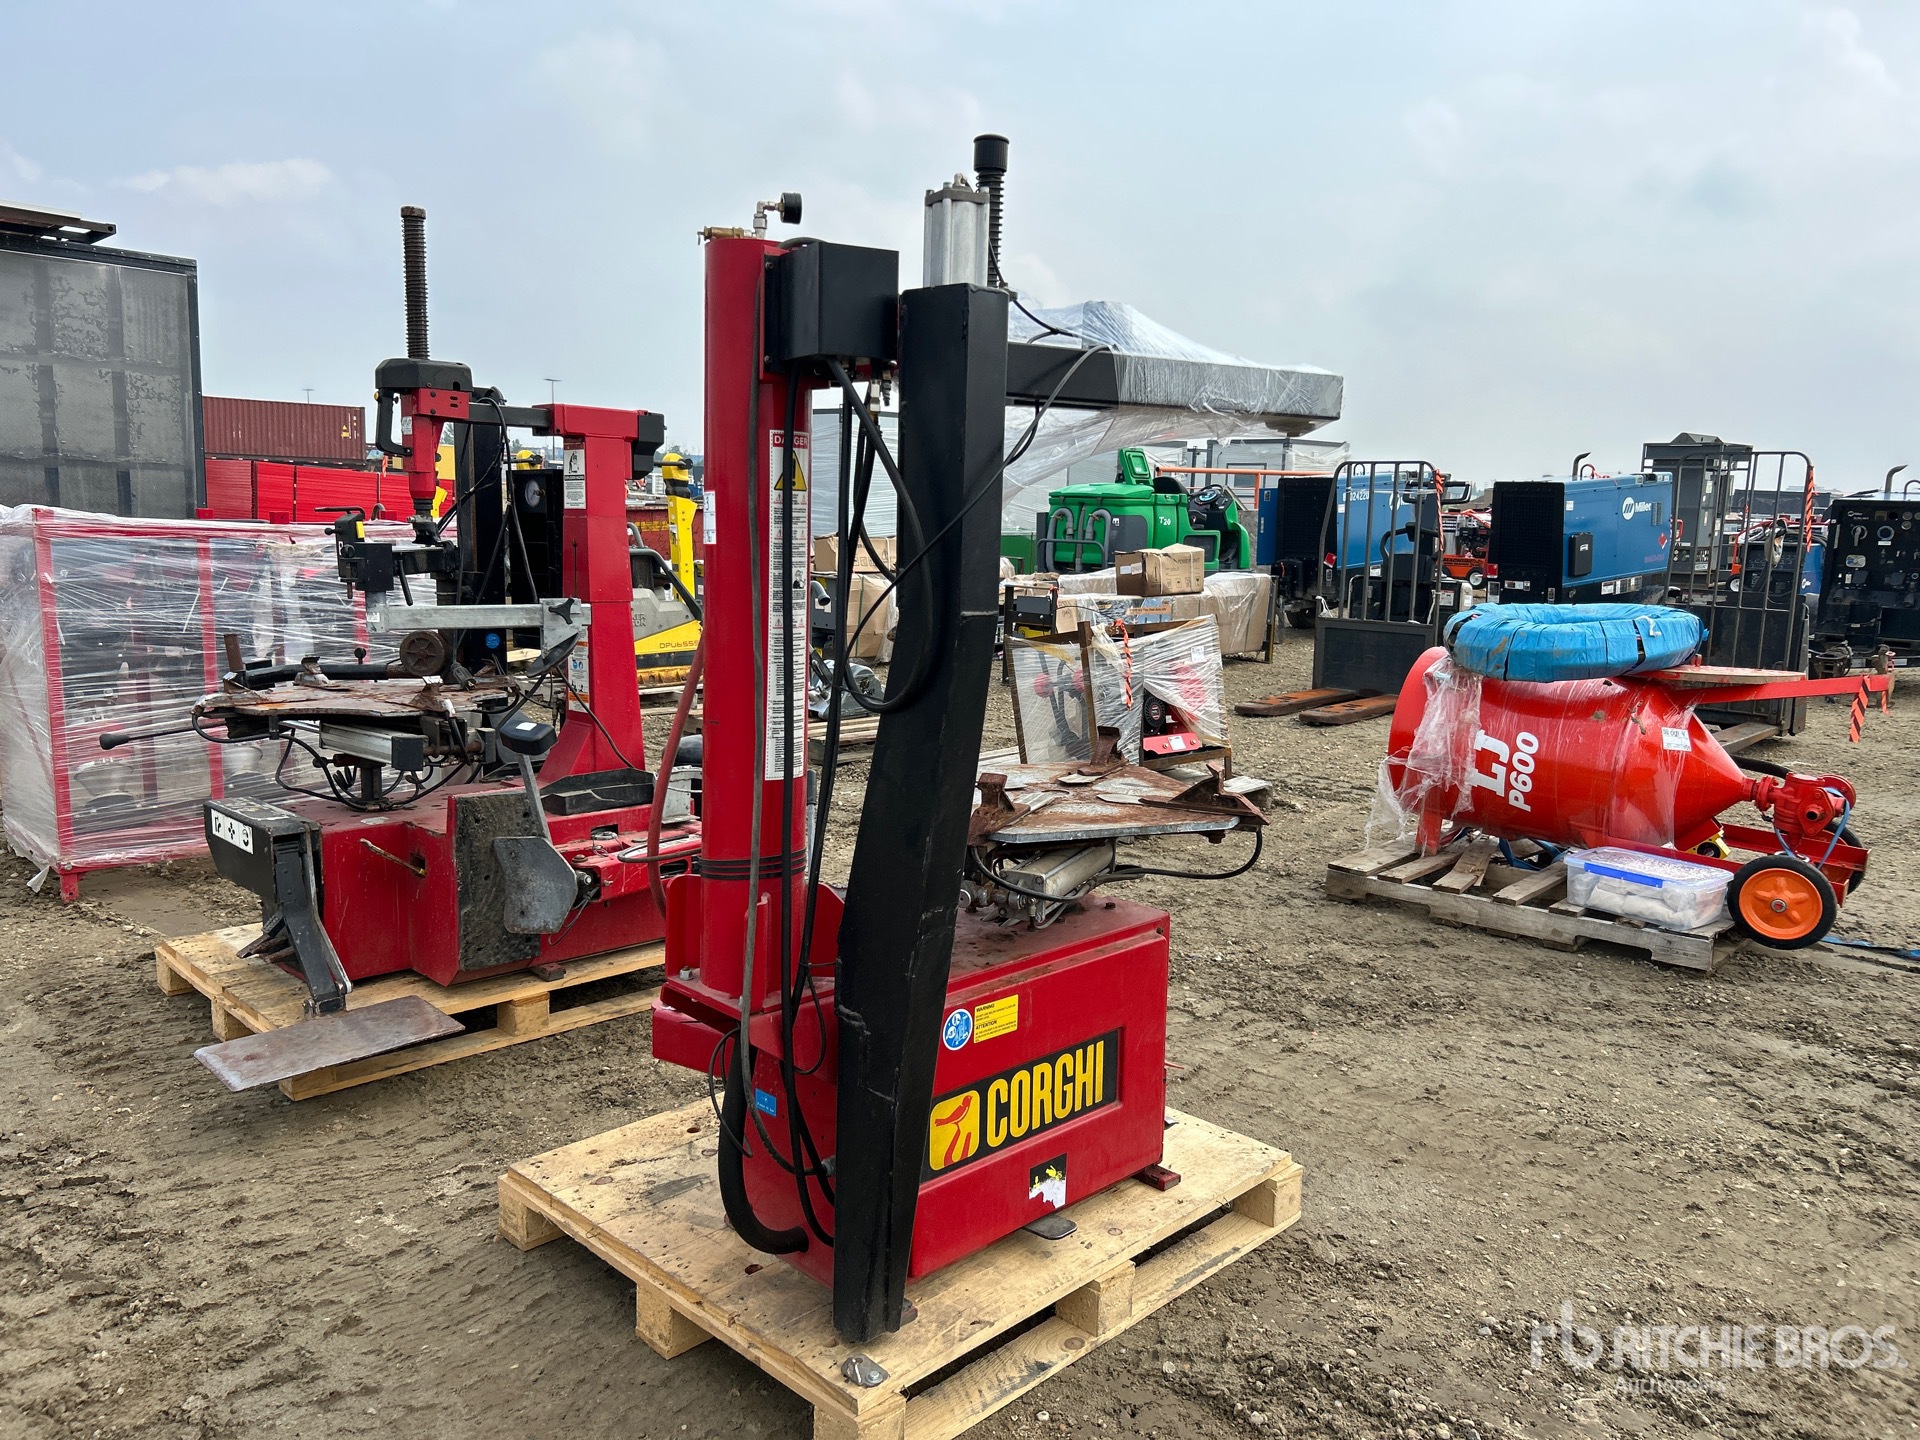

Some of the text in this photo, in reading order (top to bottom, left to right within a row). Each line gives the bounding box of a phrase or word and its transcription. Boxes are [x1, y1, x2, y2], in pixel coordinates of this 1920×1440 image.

[774, 435, 808, 446] DGER
[1469, 729, 1510, 797] LJ
[1508, 731, 1539, 812] P600
[976, 1003, 995, 1012] WARNING
[976, 1020, 997, 1030] ATTENTION
[987, 1040, 1104, 1147] CORGHI
